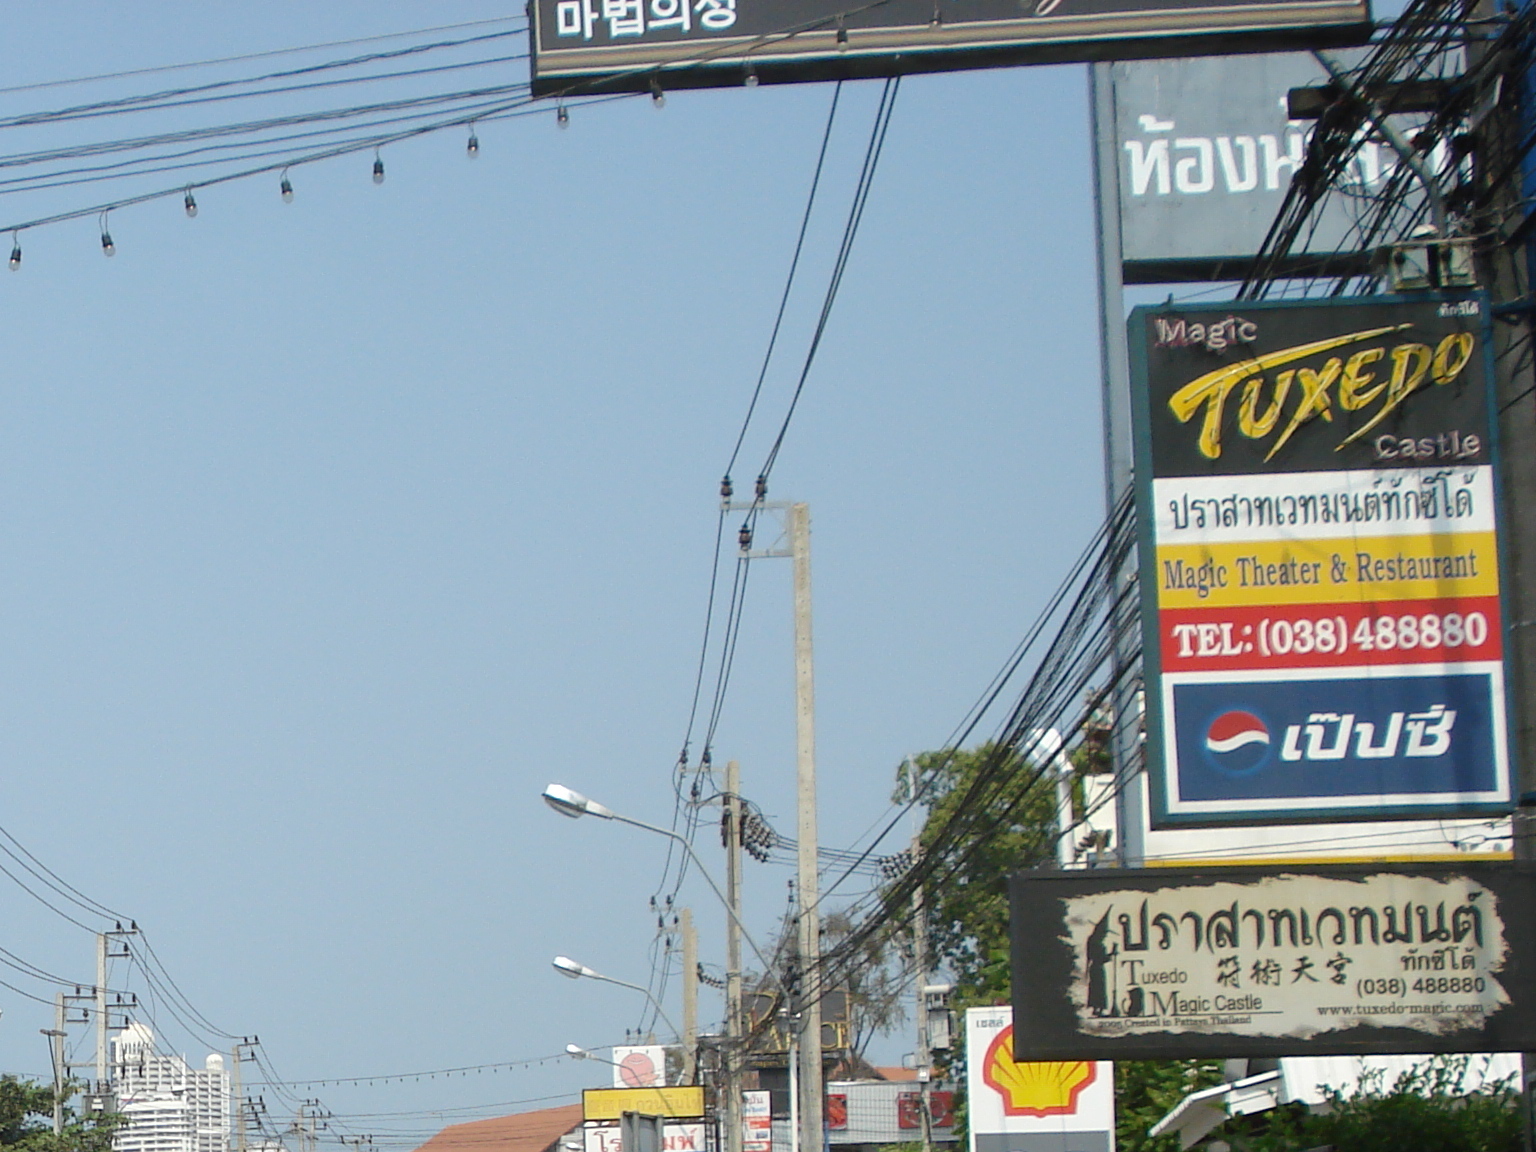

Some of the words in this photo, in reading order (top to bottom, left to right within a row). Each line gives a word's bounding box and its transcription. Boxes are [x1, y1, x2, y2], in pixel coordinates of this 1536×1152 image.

[1155, 316, 1258, 350] Magic
[1168, 322, 1474, 462] TUXEDO
[1375, 429, 1481, 460] Castle
[1164, 557, 1228, 598] Magic
[1236, 555, 1321, 587] Theater
[1331, 554, 1348, 584] &
[1356, 549, 1479, 583] Restaurant
[1352, 611, 1488, 651] 488880
[1118, 891, 1484, 954] ปราสาทเวทมนต์
[1121, 959, 1188, 987] Tuxedo
[1357, 978, 1407, 999] (038)
[1412, 976, 1486, 995] 488880
[1150, 990, 1211, 1017] Magic
[1215, 994, 1263, 1012] Castle
